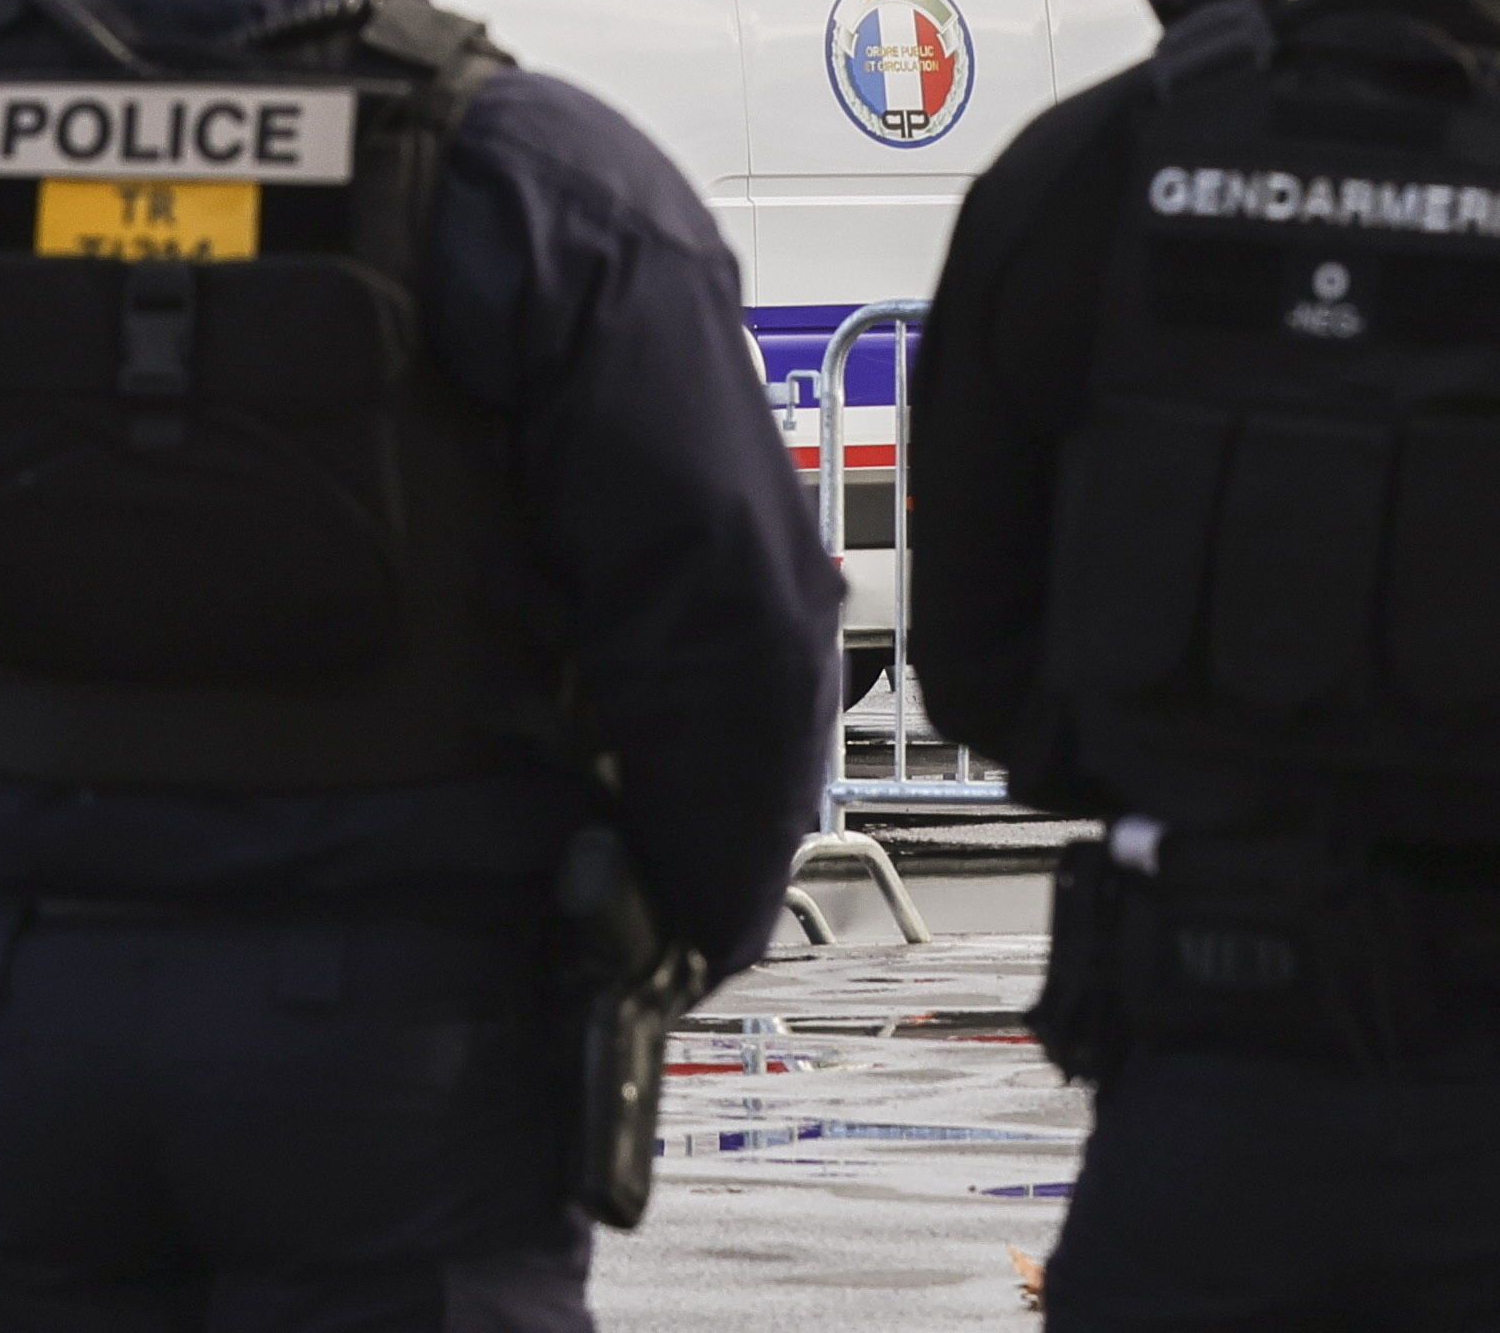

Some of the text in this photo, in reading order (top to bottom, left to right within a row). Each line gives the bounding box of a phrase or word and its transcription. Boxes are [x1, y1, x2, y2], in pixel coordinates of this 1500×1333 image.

[865, 45, 935, 58] ORDRE PUBLIC
[877, 60, 939, 73] CIRCULATION
[0, 95, 303, 166] POLICE
